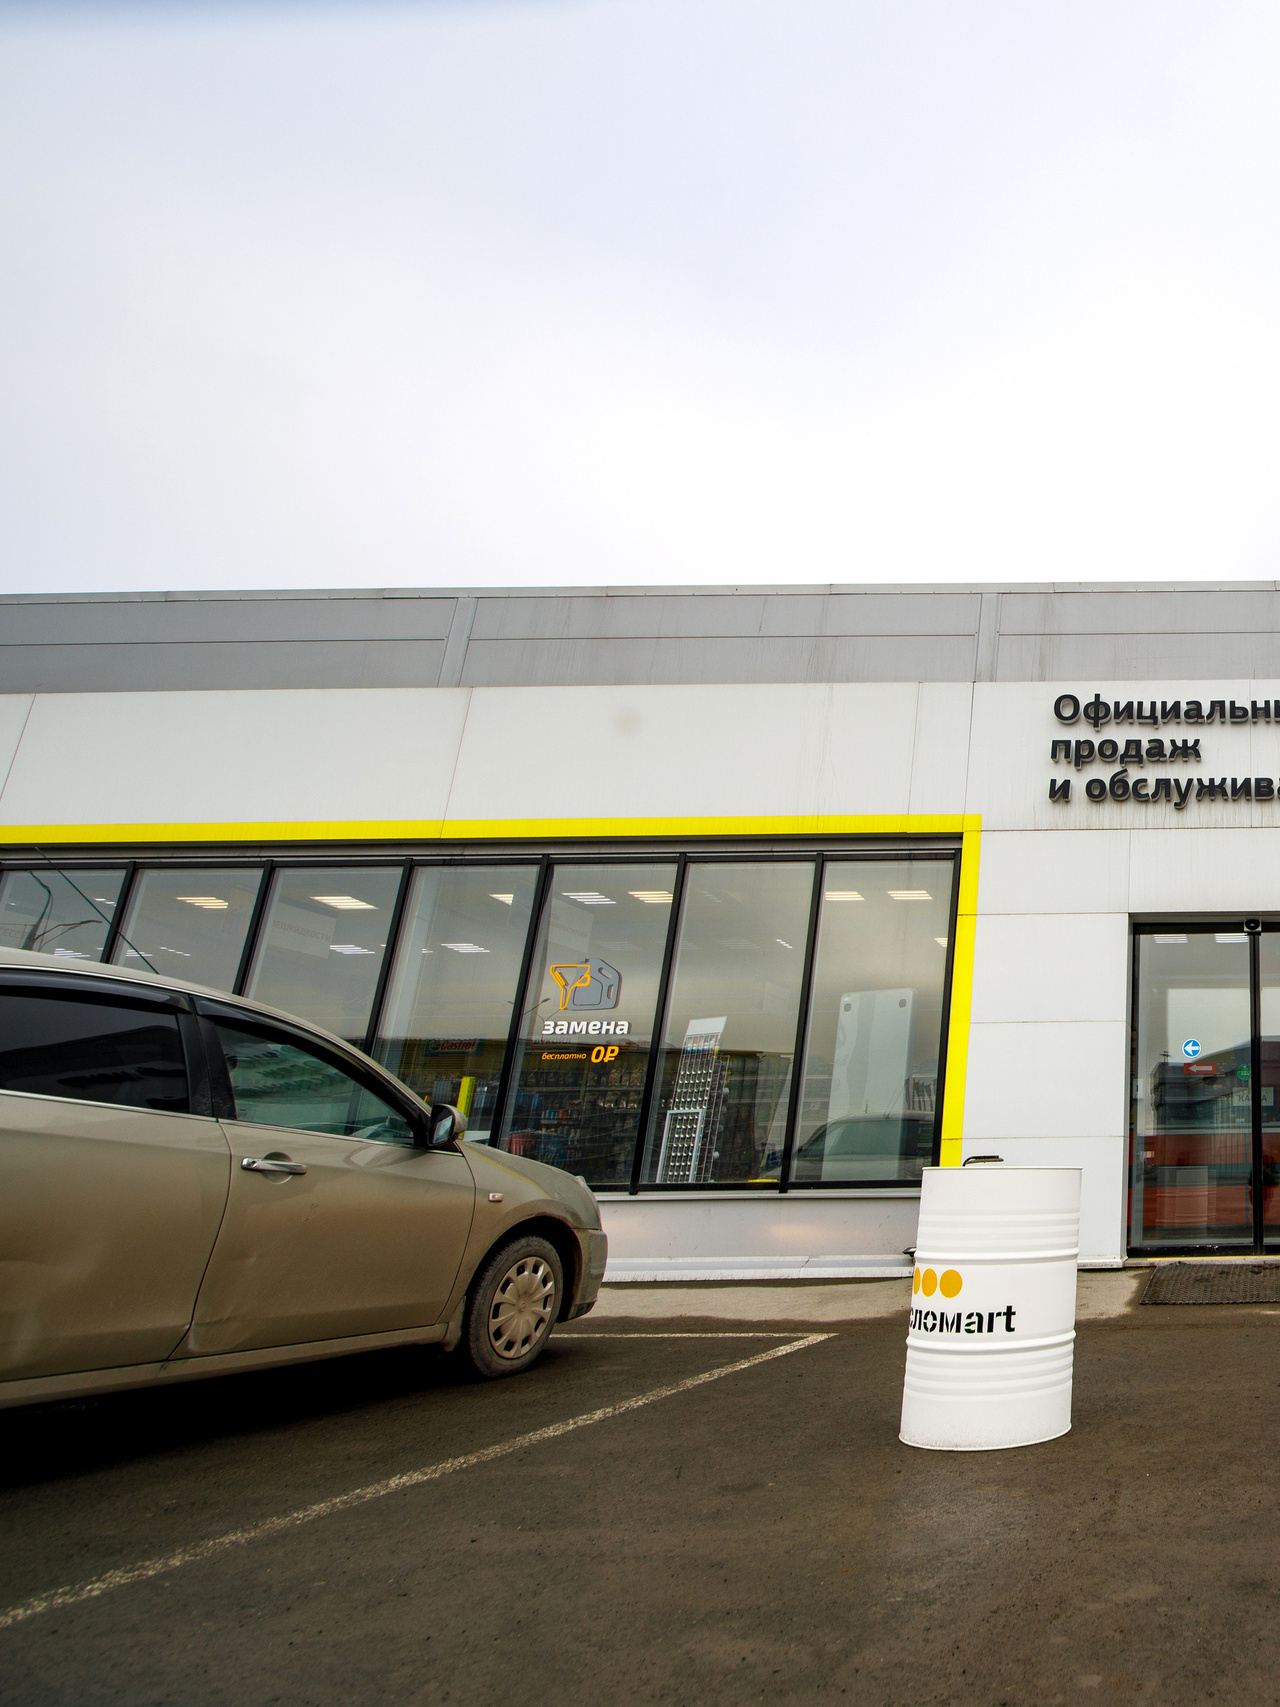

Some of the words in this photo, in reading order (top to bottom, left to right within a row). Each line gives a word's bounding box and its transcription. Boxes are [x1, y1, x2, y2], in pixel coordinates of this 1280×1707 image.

[1051, 738, 1201, 769] продаж
[1049, 778, 1071, 801] и
[541, 1020, 629, 1035] замена
[440, 1039, 477, 1051] Castrol
[541, 1051, 587, 1060] бесплатно
